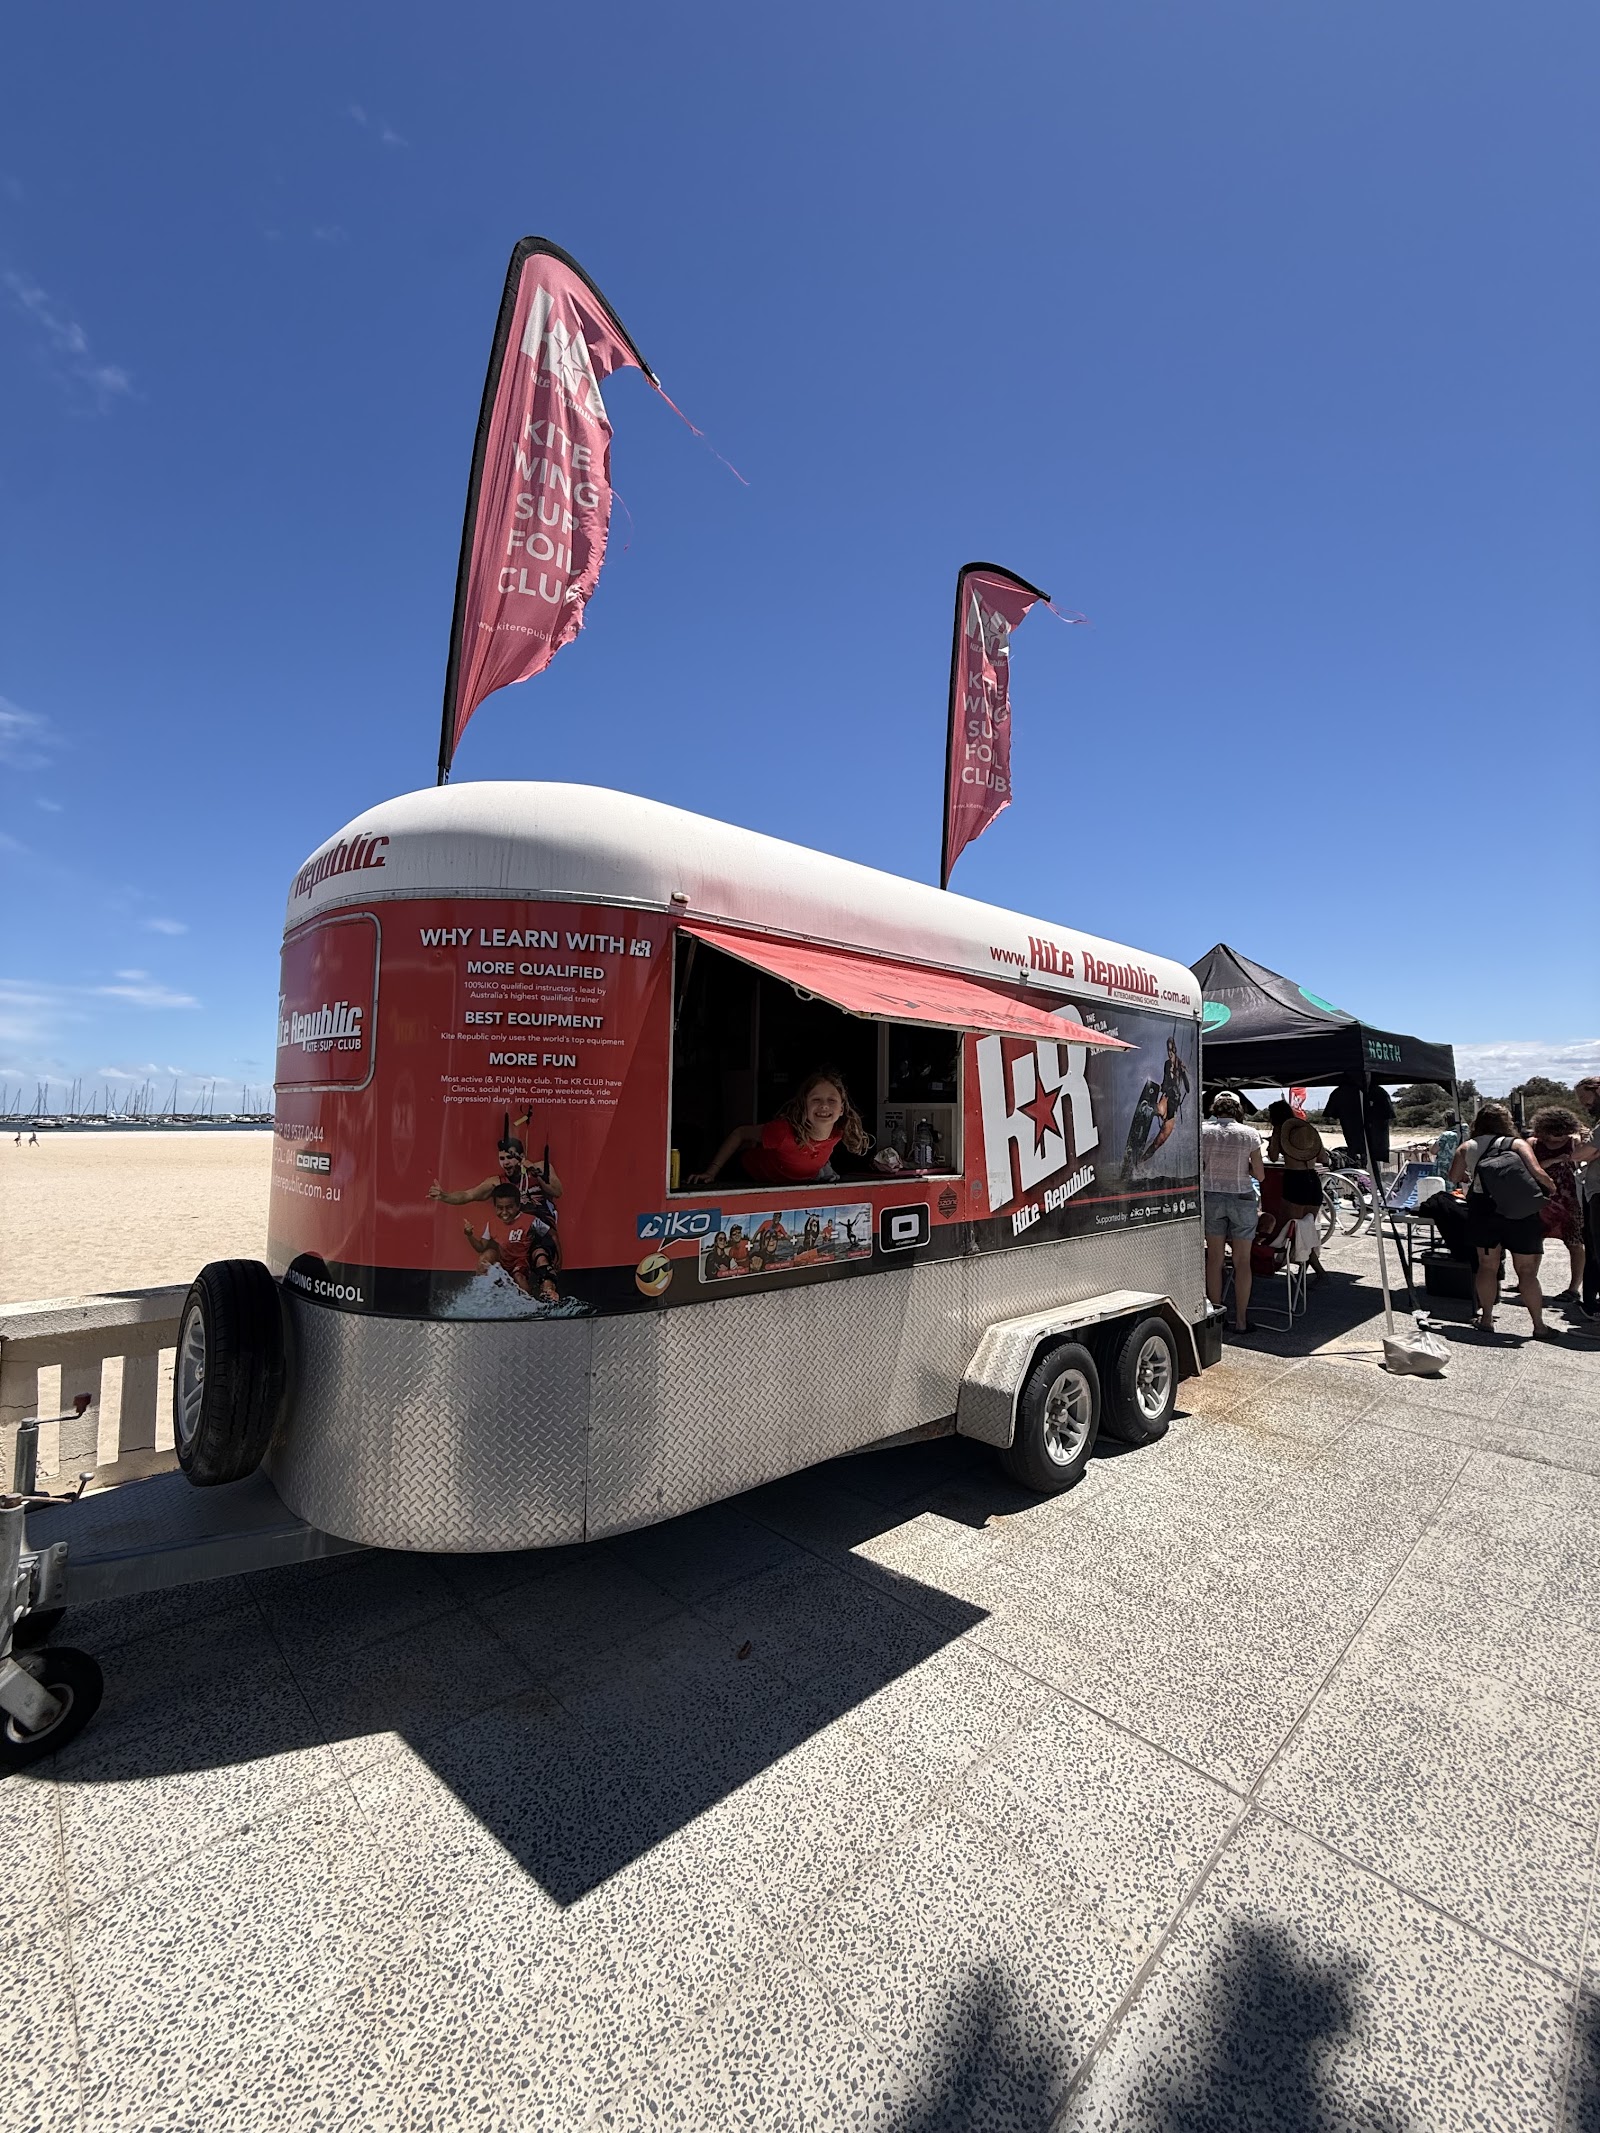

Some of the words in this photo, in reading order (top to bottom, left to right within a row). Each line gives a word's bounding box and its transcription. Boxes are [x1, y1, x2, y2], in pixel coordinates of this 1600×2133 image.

[523, 412, 592, 472] KITE
[512, 441, 600, 508] WING
[514, 492, 580, 535] SUP
[506, 527, 582, 576] FOIL
[961, 767, 1007, 792] CLUB
[294, 831, 390, 899] Republic
[420, 928, 473, 946] WHY
[480, 929, 558, 949] LEARN
[565, 931, 625, 954] WITH
[467, 960, 515, 975] MORE
[519, 962, 605, 980] QUALIFIED
[989, 946, 1028, 968] www.
[1027, 935, 1075, 979] Kite
[1081, 950, 1159, 998] Republic
[1160, 989, 1191, 1006] .com.au
[464, 981, 499, 989] 100%IKO
[500, 982, 534, 992] qualified
[535, 983, 578, 994] instructors,
[579, 985, 596, 994] lead
[597, 987, 606, 996] by
[470, 991, 508, 999] Australia's
[510, 992, 539, 1002] highest
[540, 993, 573, 1003] qualified
[574, 995, 600, 1003] trainer
[1113, 990, 1143, 1004] KITEBOARDING
[1143, 997, 1159, 1006] SCHOOL
[290, 1001, 363, 1051] Republic
[465, 1011, 503, 1025] BEST
[508, 1012, 603, 1029] EQUIPMENT
[441, 1032, 456, 1040] Kite
[457, 1032, 489, 1041] Republic
[491, 1034, 507, 1042] only
[509, 1034, 526, 1042] uses
[528, 1034, 541, 1042] the
[543, 1035, 570, 1043] world's
[571, 1037, 585, 1046] top
[586, 1037, 625, 1047] equipment
[489, 1052, 538, 1066] MORE
[542, 1054, 576, 1067] FUN
[1368, 1039, 1402, 1062] NORTH
[440, 1074, 459, 1083] Most
[460, 1075, 483, 1083] active
[484, 1075, 494, 1084] (&
[495, 1076, 516, 1085] FUN)
[517, 1077, 532, 1085] kite
[534, 1077, 552, 1085] club.
[570, 1078, 582, 1086] KR
[583, 1078, 604, 1086] CLUB
[605, 1079, 622, 1087] have
[451, 1085, 477, 1094] Clinics,
[502, 1086, 528, 1095] nights,
[530, 1087, 553, 1096] Camp
[555, 1087, 595, 1096] weekends,
[596, 1088, 611, 1096] ride
[443, 1095, 492, 1104] (progression)
[493, 1096, 513, 1105] days,
[514, 1096, 567, 1104] internationals
[597, 1098, 619, 1106] more!
[291, 1124, 304, 1140] 9537
[305, 1125, 324, 1142] 0644
[1011, 1202, 1041, 1237] Kite
[1043, 1164, 1096, 1214] Republic
[1095, 1211, 1121, 1225] Supported
[314, 1279, 364, 1303] SCHOOL
